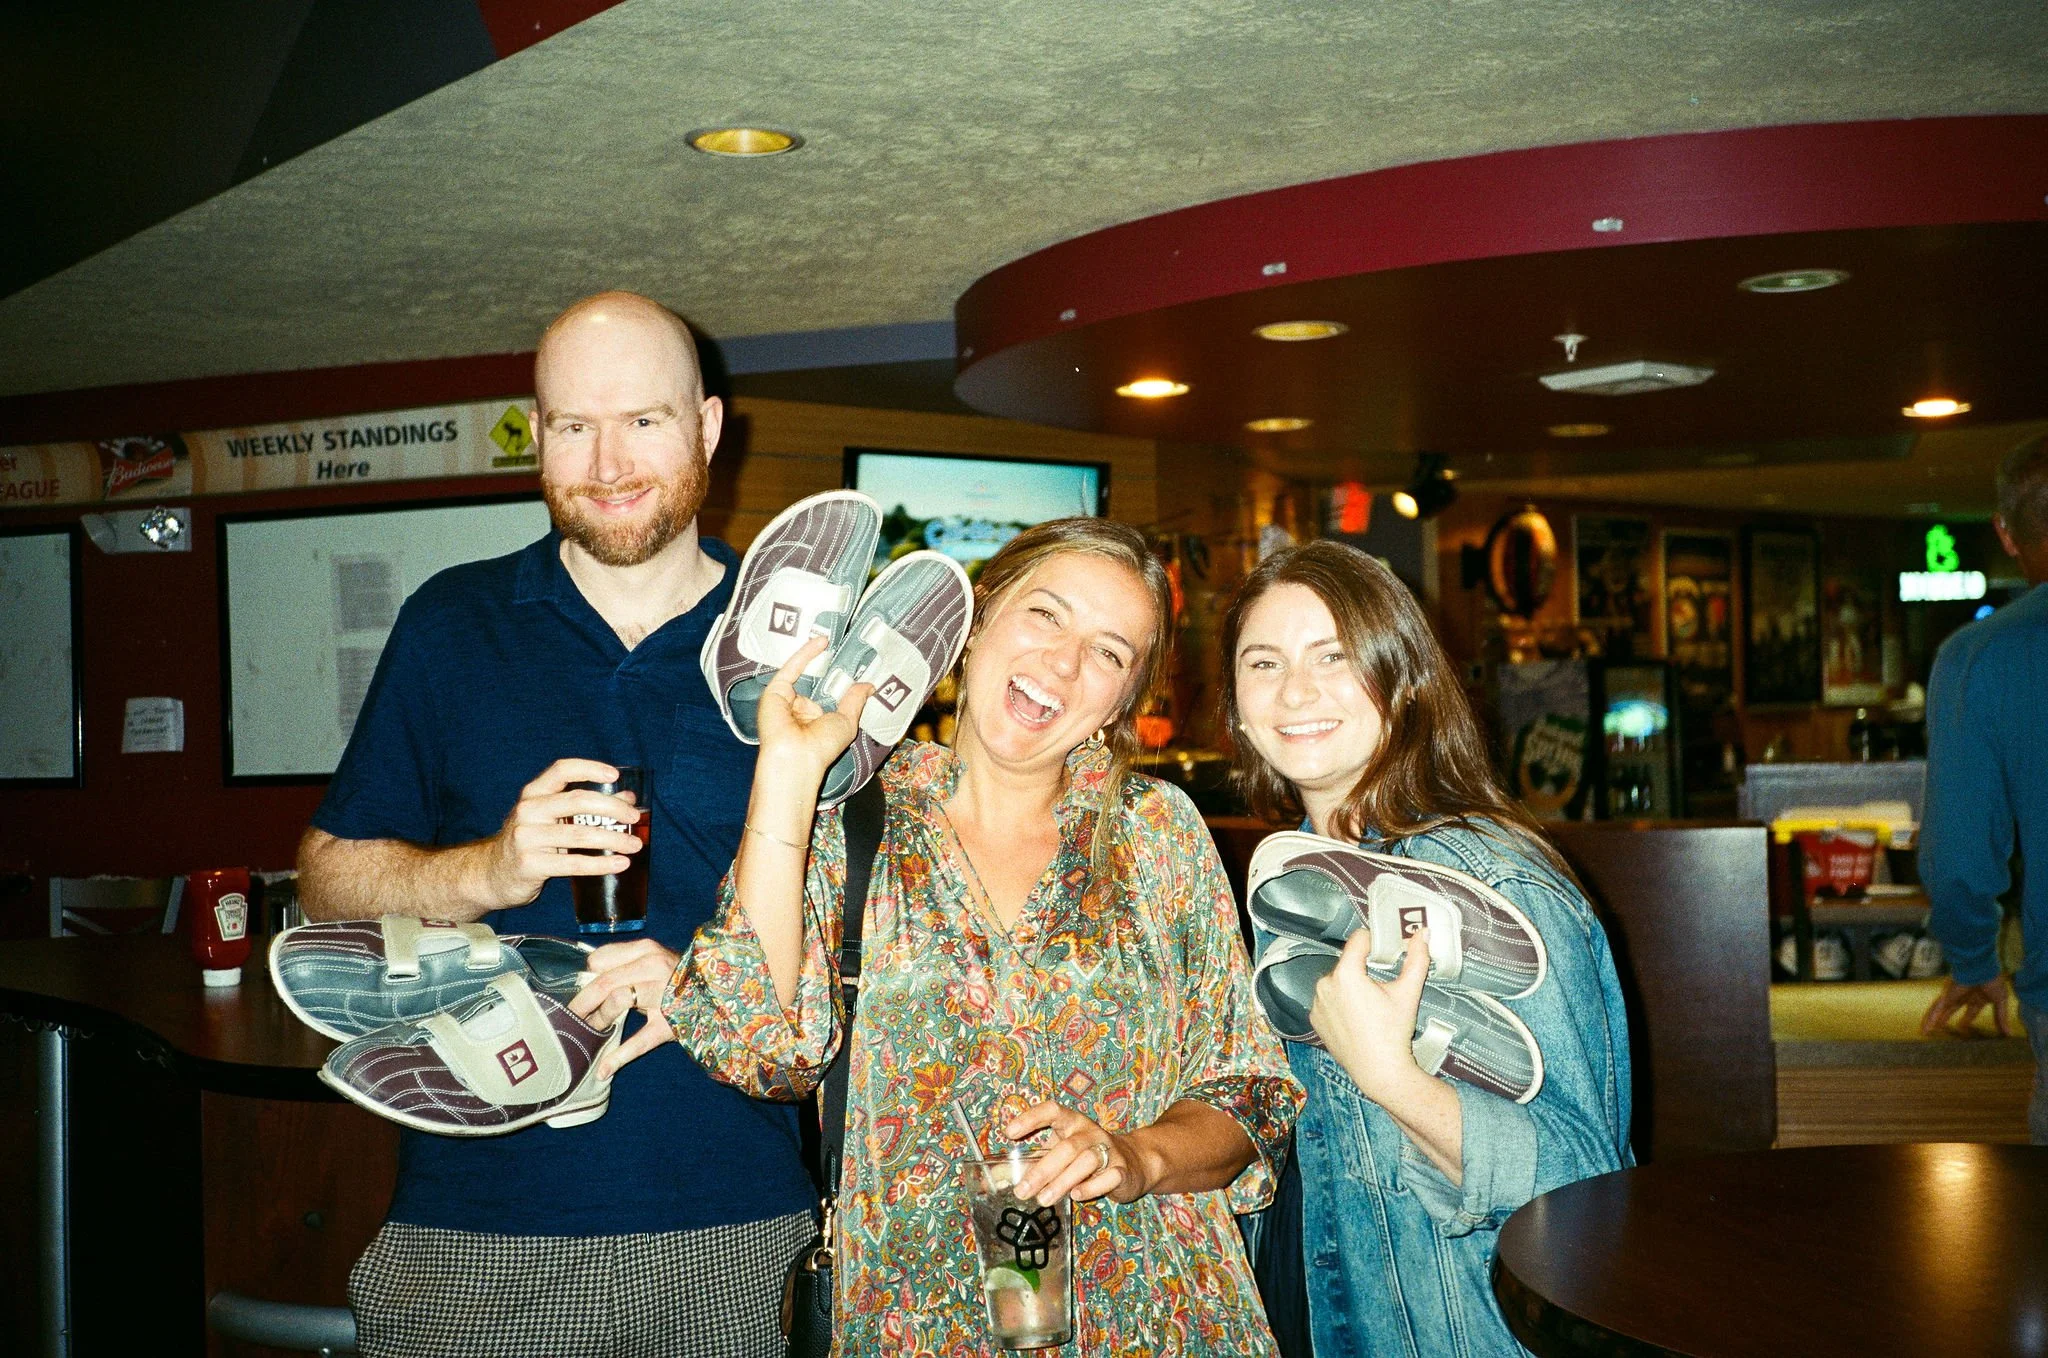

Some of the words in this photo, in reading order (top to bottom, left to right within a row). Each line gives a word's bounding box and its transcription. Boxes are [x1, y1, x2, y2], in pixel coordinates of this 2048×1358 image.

[226, 432, 315, 458] WEEKLY
[322, 420, 458, 451] STANDINGS
[316, 460, 371, 480] Here
